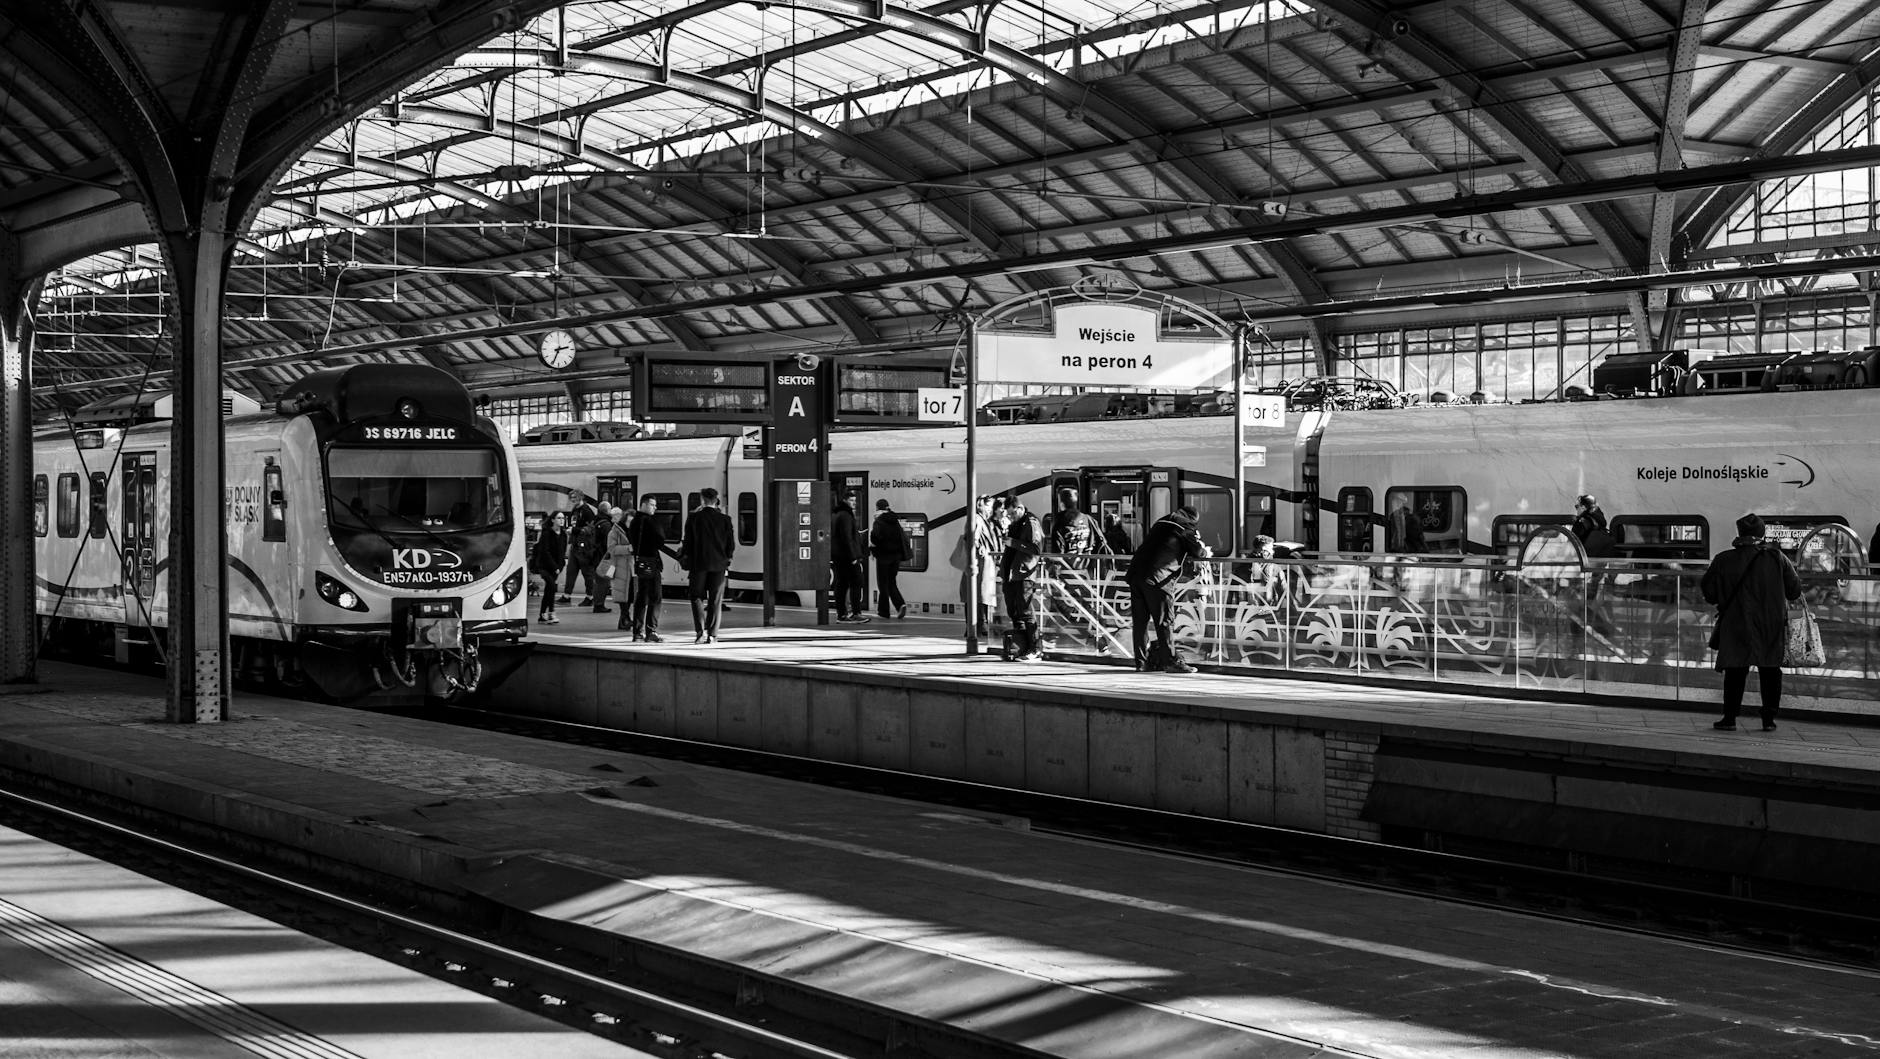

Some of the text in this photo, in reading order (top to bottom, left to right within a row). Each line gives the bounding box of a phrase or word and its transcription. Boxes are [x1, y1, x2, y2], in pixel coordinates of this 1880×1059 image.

[1079, 327, 1135, 344] Wejście
[1061, 354, 1153, 371] na peron 4
[778, 376, 815, 385] SEKTOR
[788, 396, 806, 417] A
[923, 395, 962, 414] tor 7
[1248, 403, 1280, 419] tor 8
[383, 427, 422, 439] 69716
[426, 428, 456, 439] JELC
[775, 444, 807, 453] PERON
[808, 438, 818, 453] 4
[1636, 464, 1769, 482] Koleje Dolnośląskie
[870, 480, 891, 490] Koleje
[892, 478, 934, 490] Dolnośląskie
[234, 486, 261, 503] DOLNY
[392, 548, 431, 569] KD
